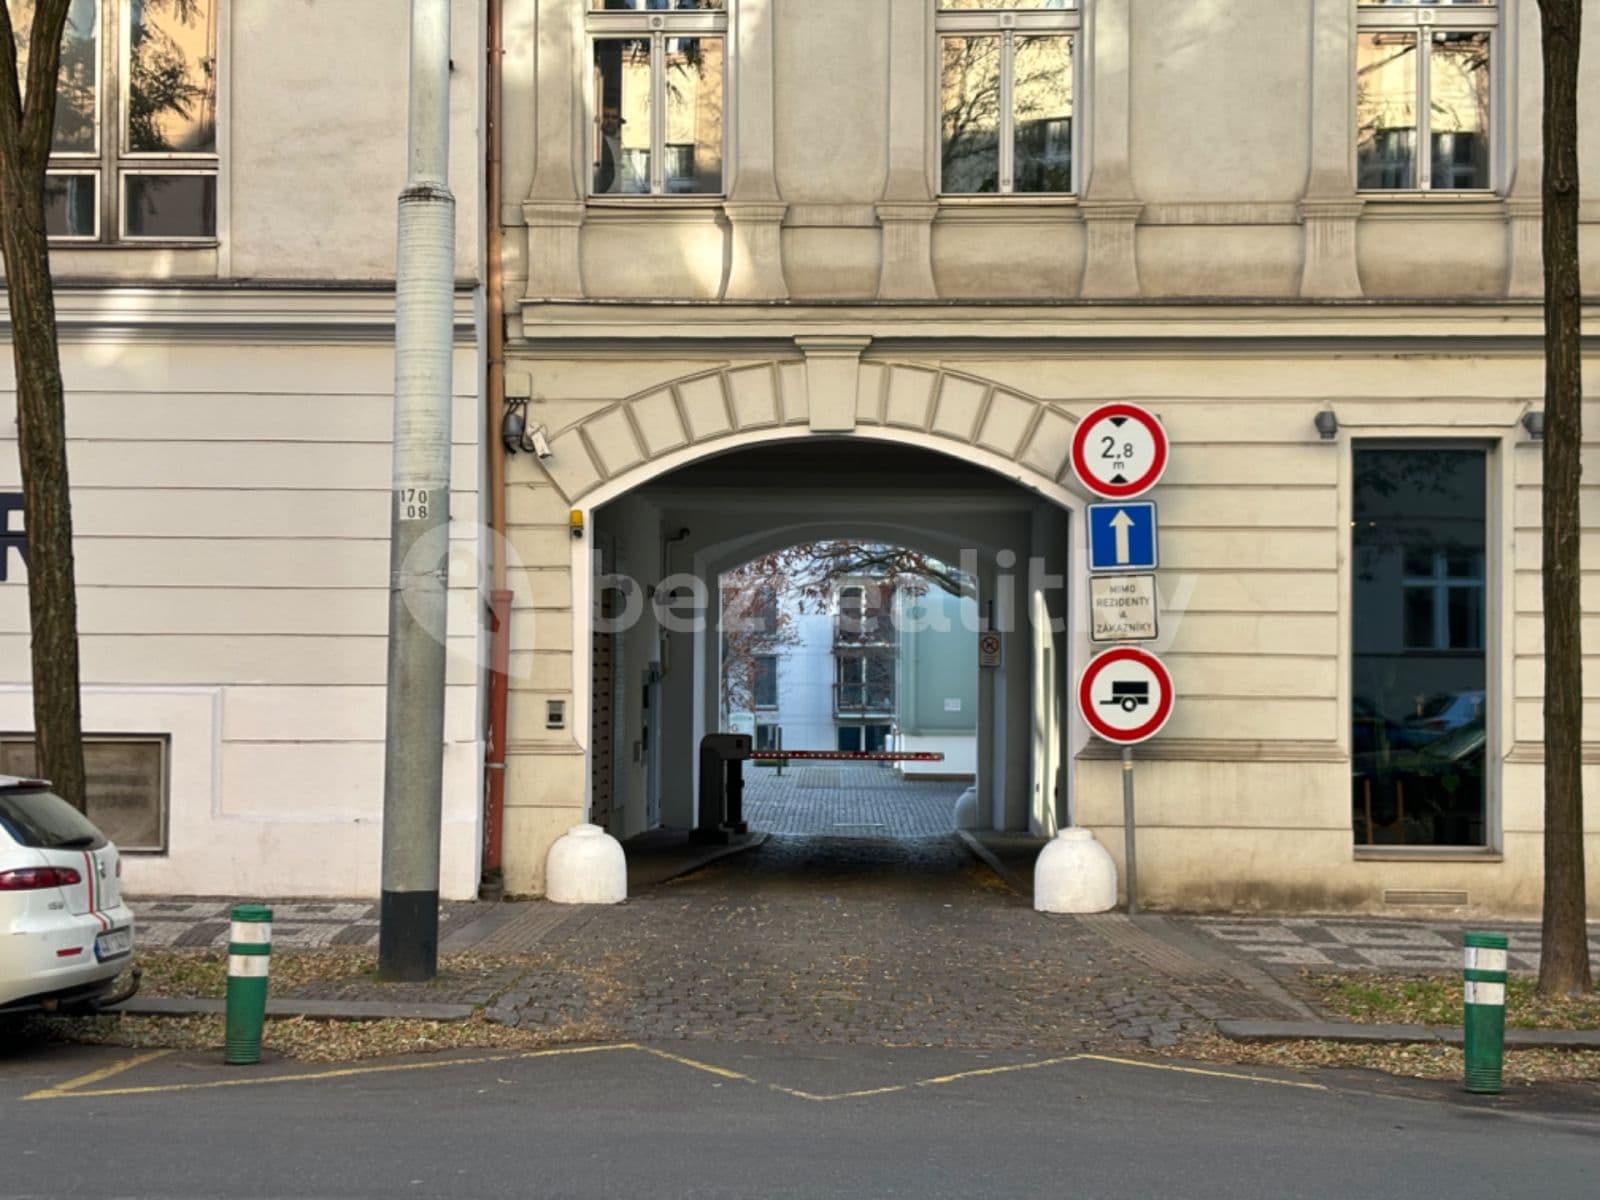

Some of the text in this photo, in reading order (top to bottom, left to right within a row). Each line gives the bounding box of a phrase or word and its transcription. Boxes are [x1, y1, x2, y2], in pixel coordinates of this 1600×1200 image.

[1113, 461, 1125, 470] m
[401, 489, 428, 503] 170
[407, 505, 428, 518] 08
[1109, 584, 1136, 593] MIMO
[1096, 597, 1150, 608] REZIDENTY
